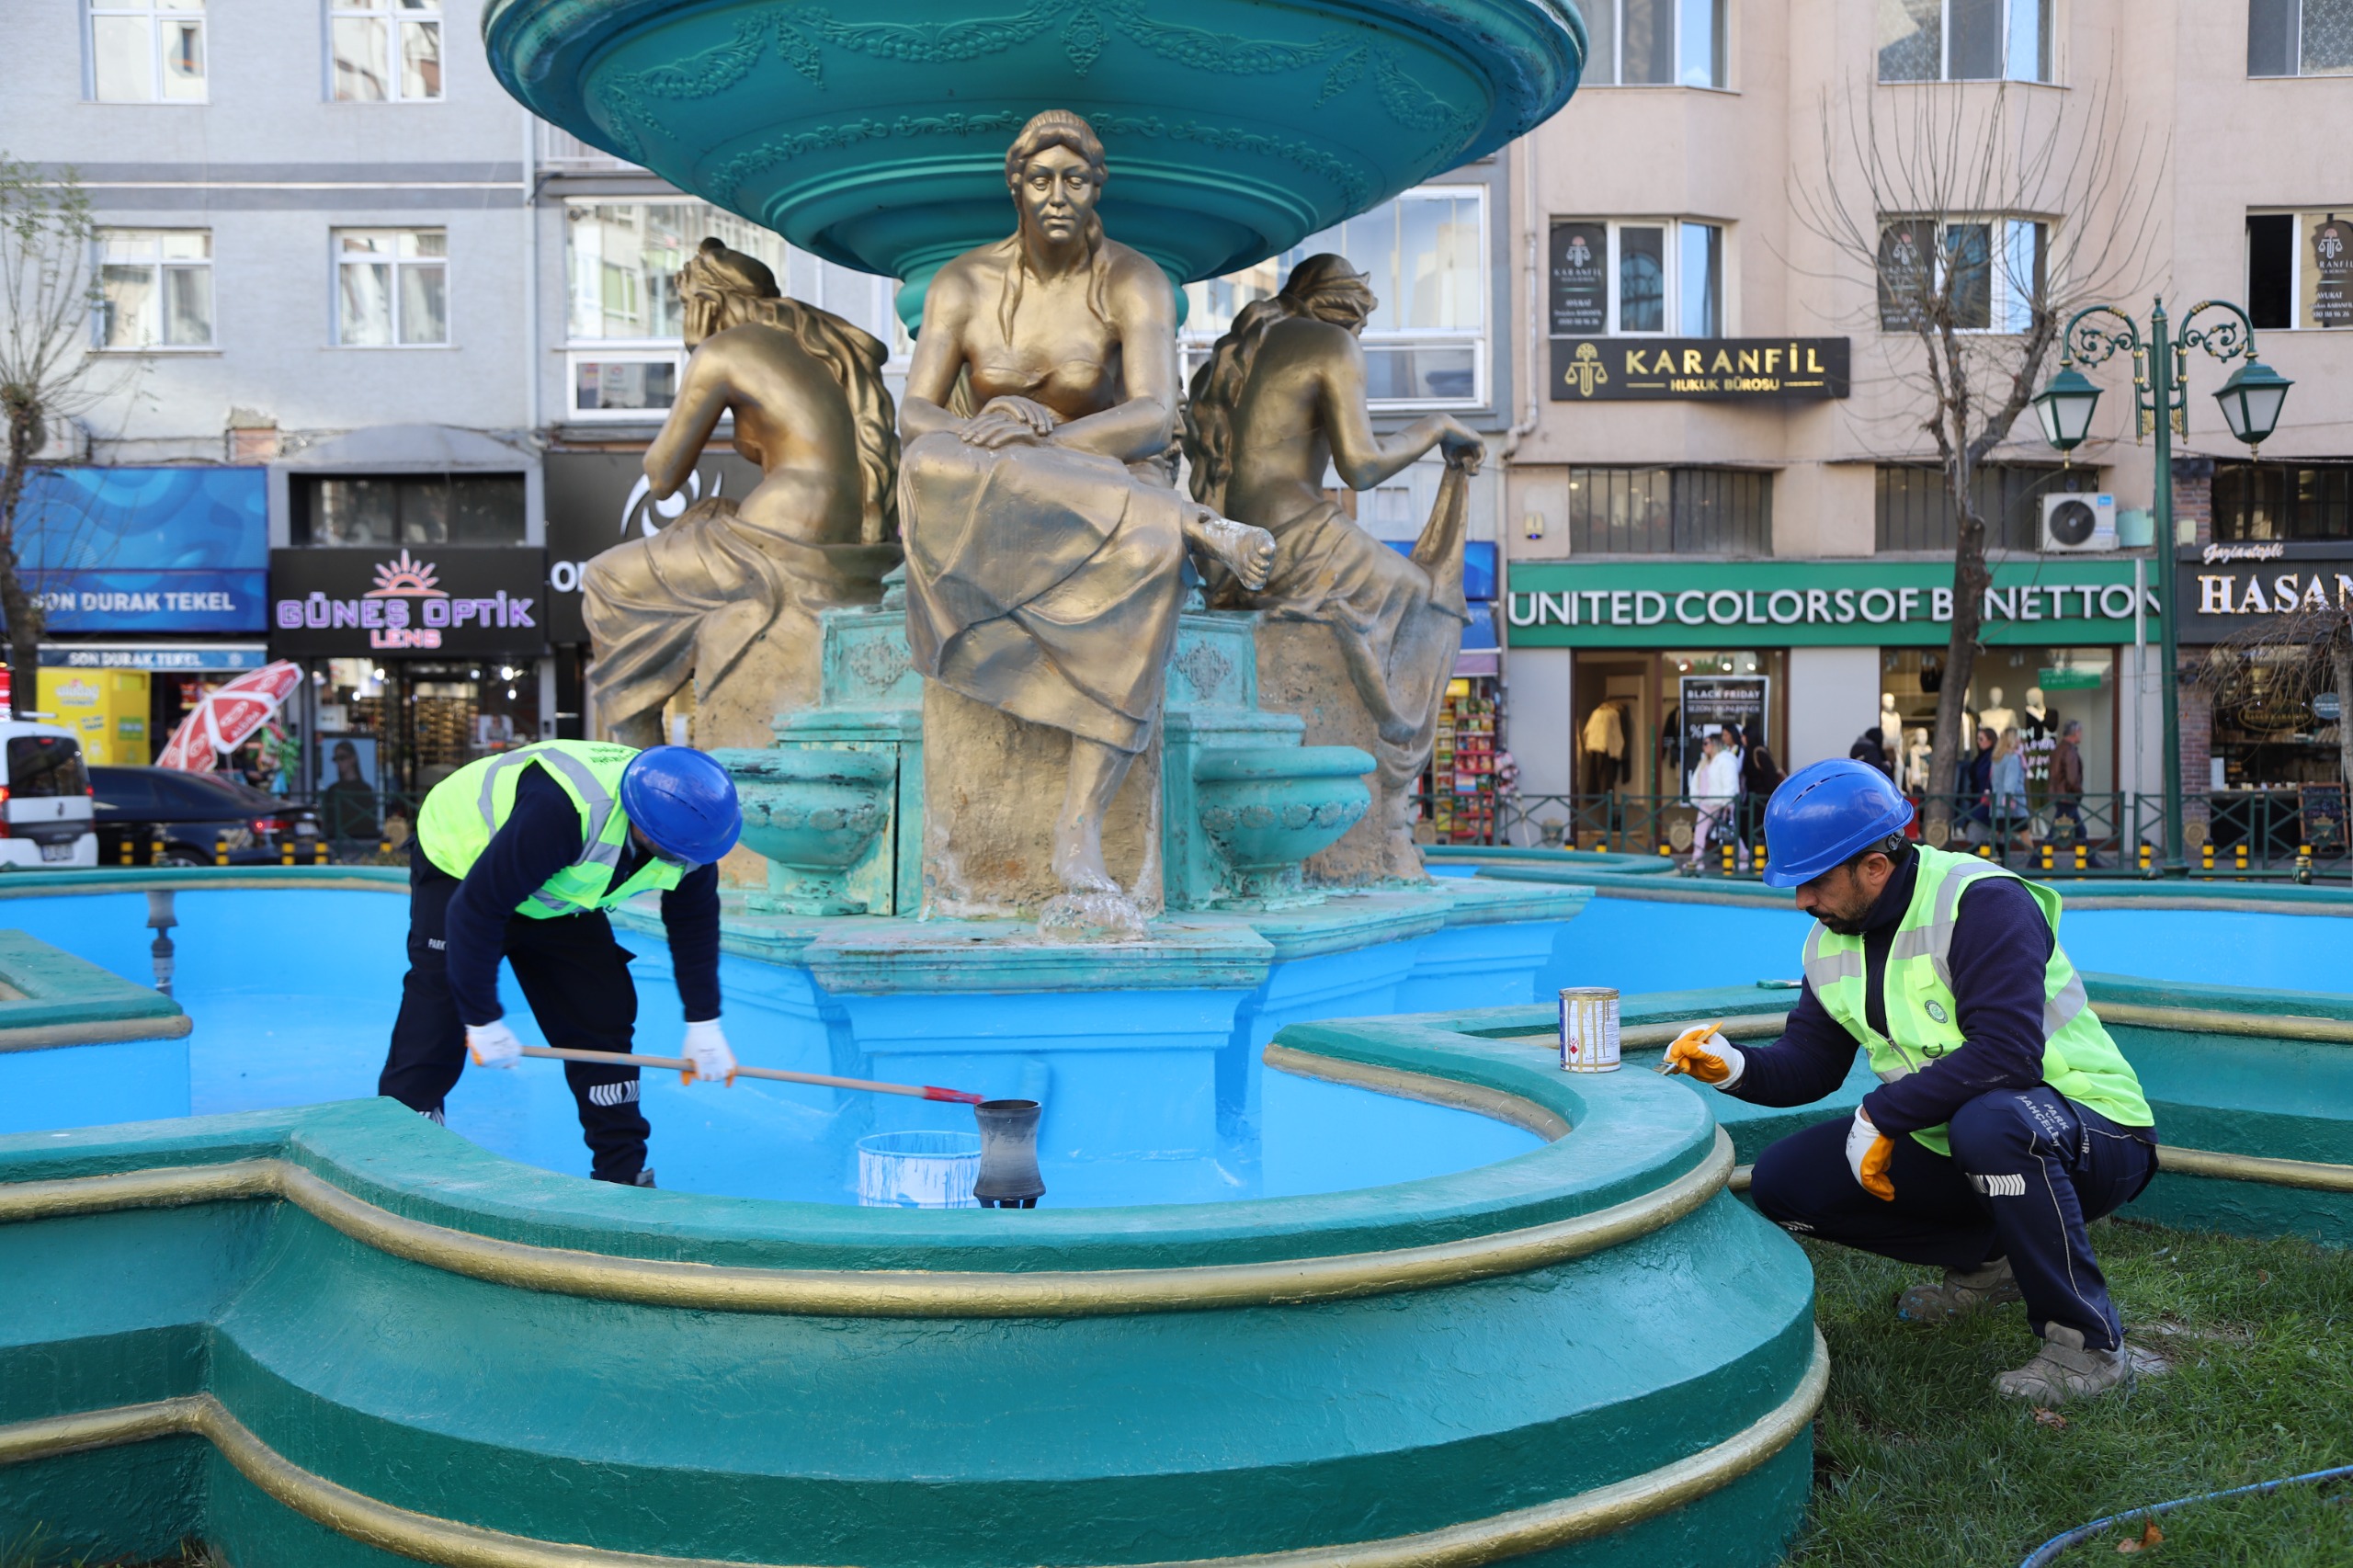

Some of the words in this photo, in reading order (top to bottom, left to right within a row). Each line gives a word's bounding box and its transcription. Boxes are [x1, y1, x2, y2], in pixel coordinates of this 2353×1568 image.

[1625, 343, 1824, 375] KARANFİL
[1670, 378, 1720, 392] HUKUK
[1724, 377, 1779, 392] BÜROSU
[2202, 542, 2284, 565] Gaziantepli
[29, 591, 76, 612] SON
[81, 592, 160, 612] DURAK
[165, 592, 236, 611] TEKEL
[277, 591, 411, 631] GÜNEŞ
[423, 590, 537, 629] OPTİK
[1507, 590, 1667, 627] UNITED
[1931, 584, 2161, 622] BNETTO
[370, 629, 442, 649] LENS
[69, 652, 99, 666] SON
[101, 652, 153, 666] DURAK
[1687, 690, 1722, 699] BLACK
[1723, 690, 1760, 699] FRIDAY
[2043, 1104, 2070, 1131] PARK
